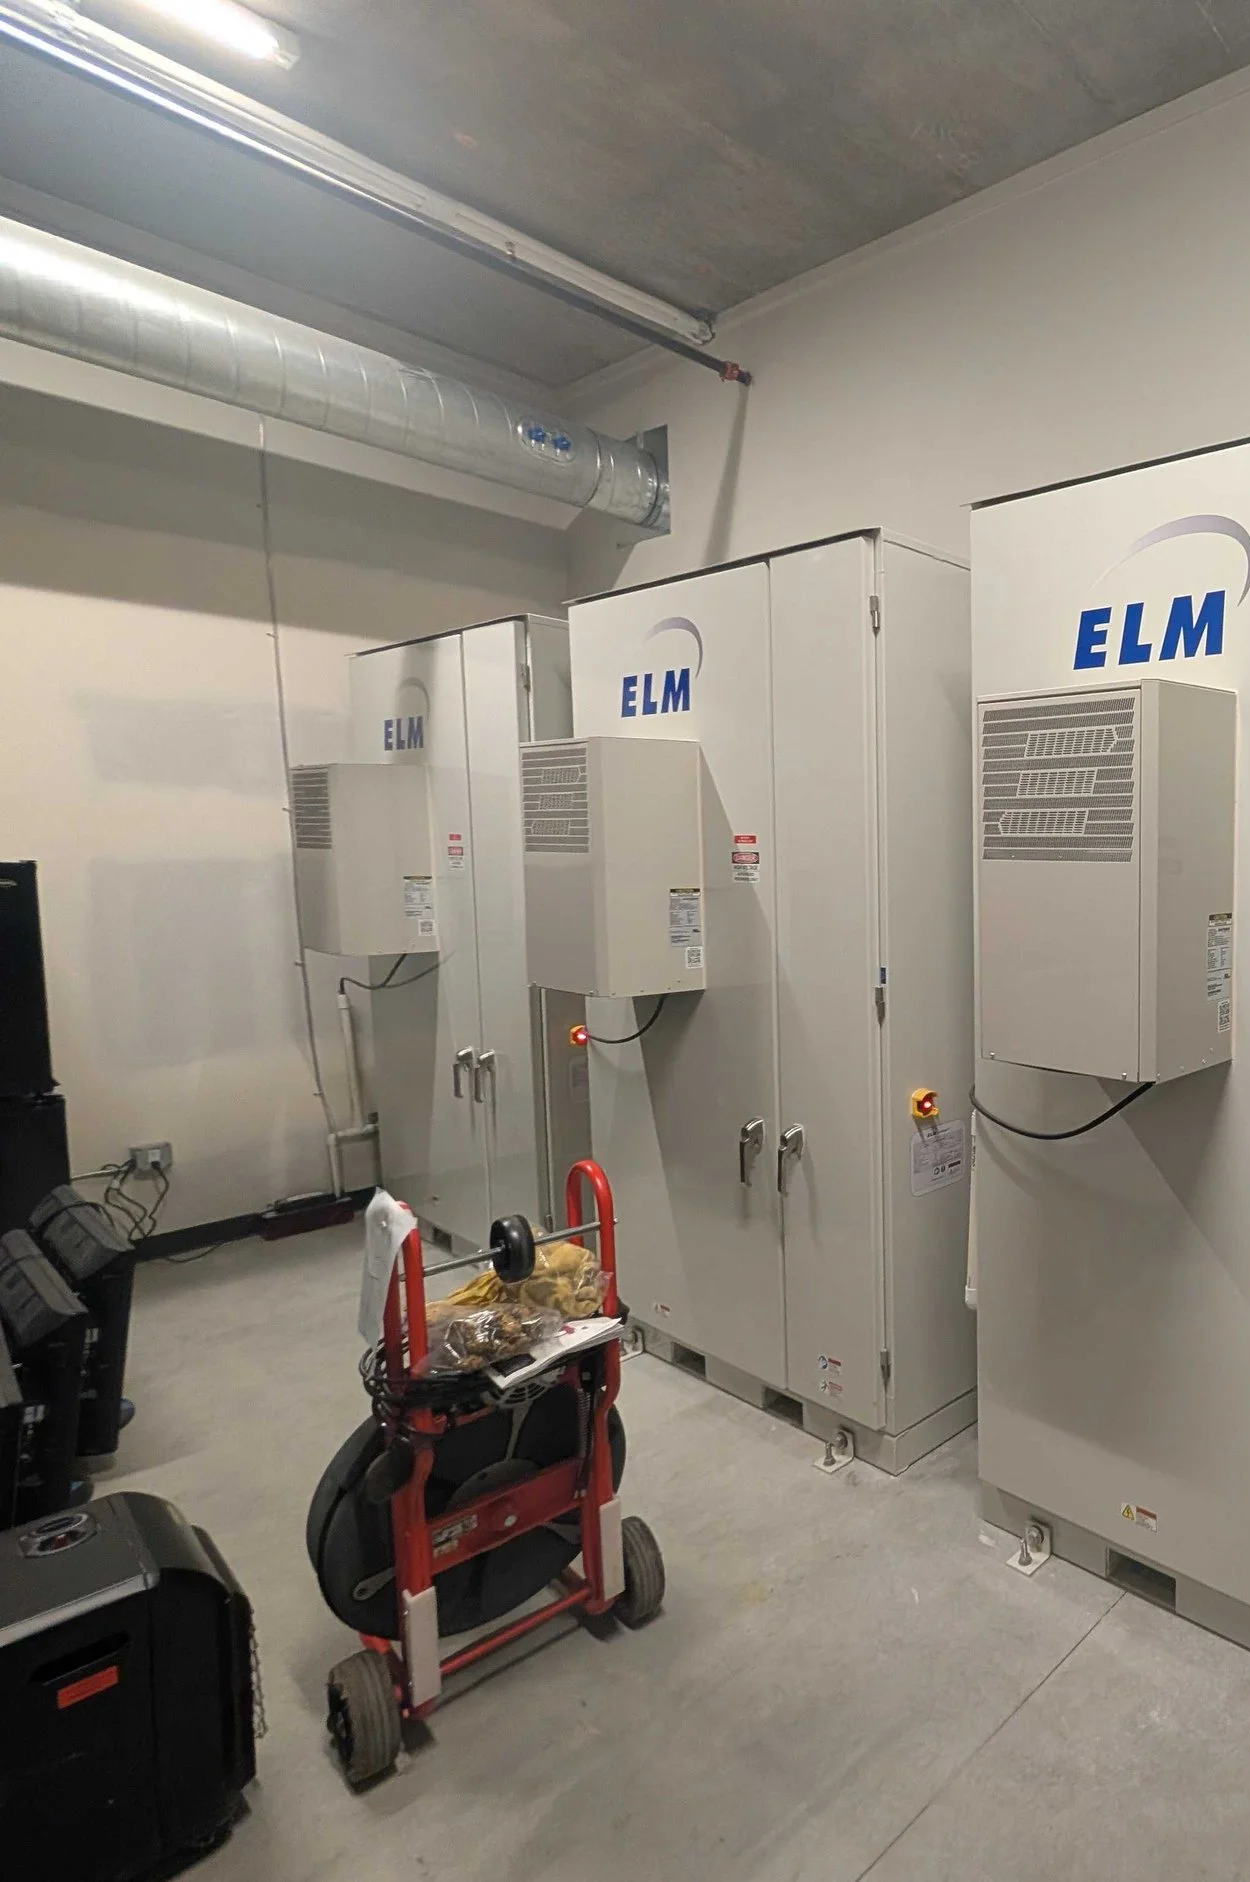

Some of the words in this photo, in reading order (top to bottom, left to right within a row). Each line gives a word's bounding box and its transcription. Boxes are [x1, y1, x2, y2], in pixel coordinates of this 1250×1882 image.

[1073, 589, 1226, 670] ELM
[621, 667, 690, 718] ELM
[384, 716, 424, 751] ELM
